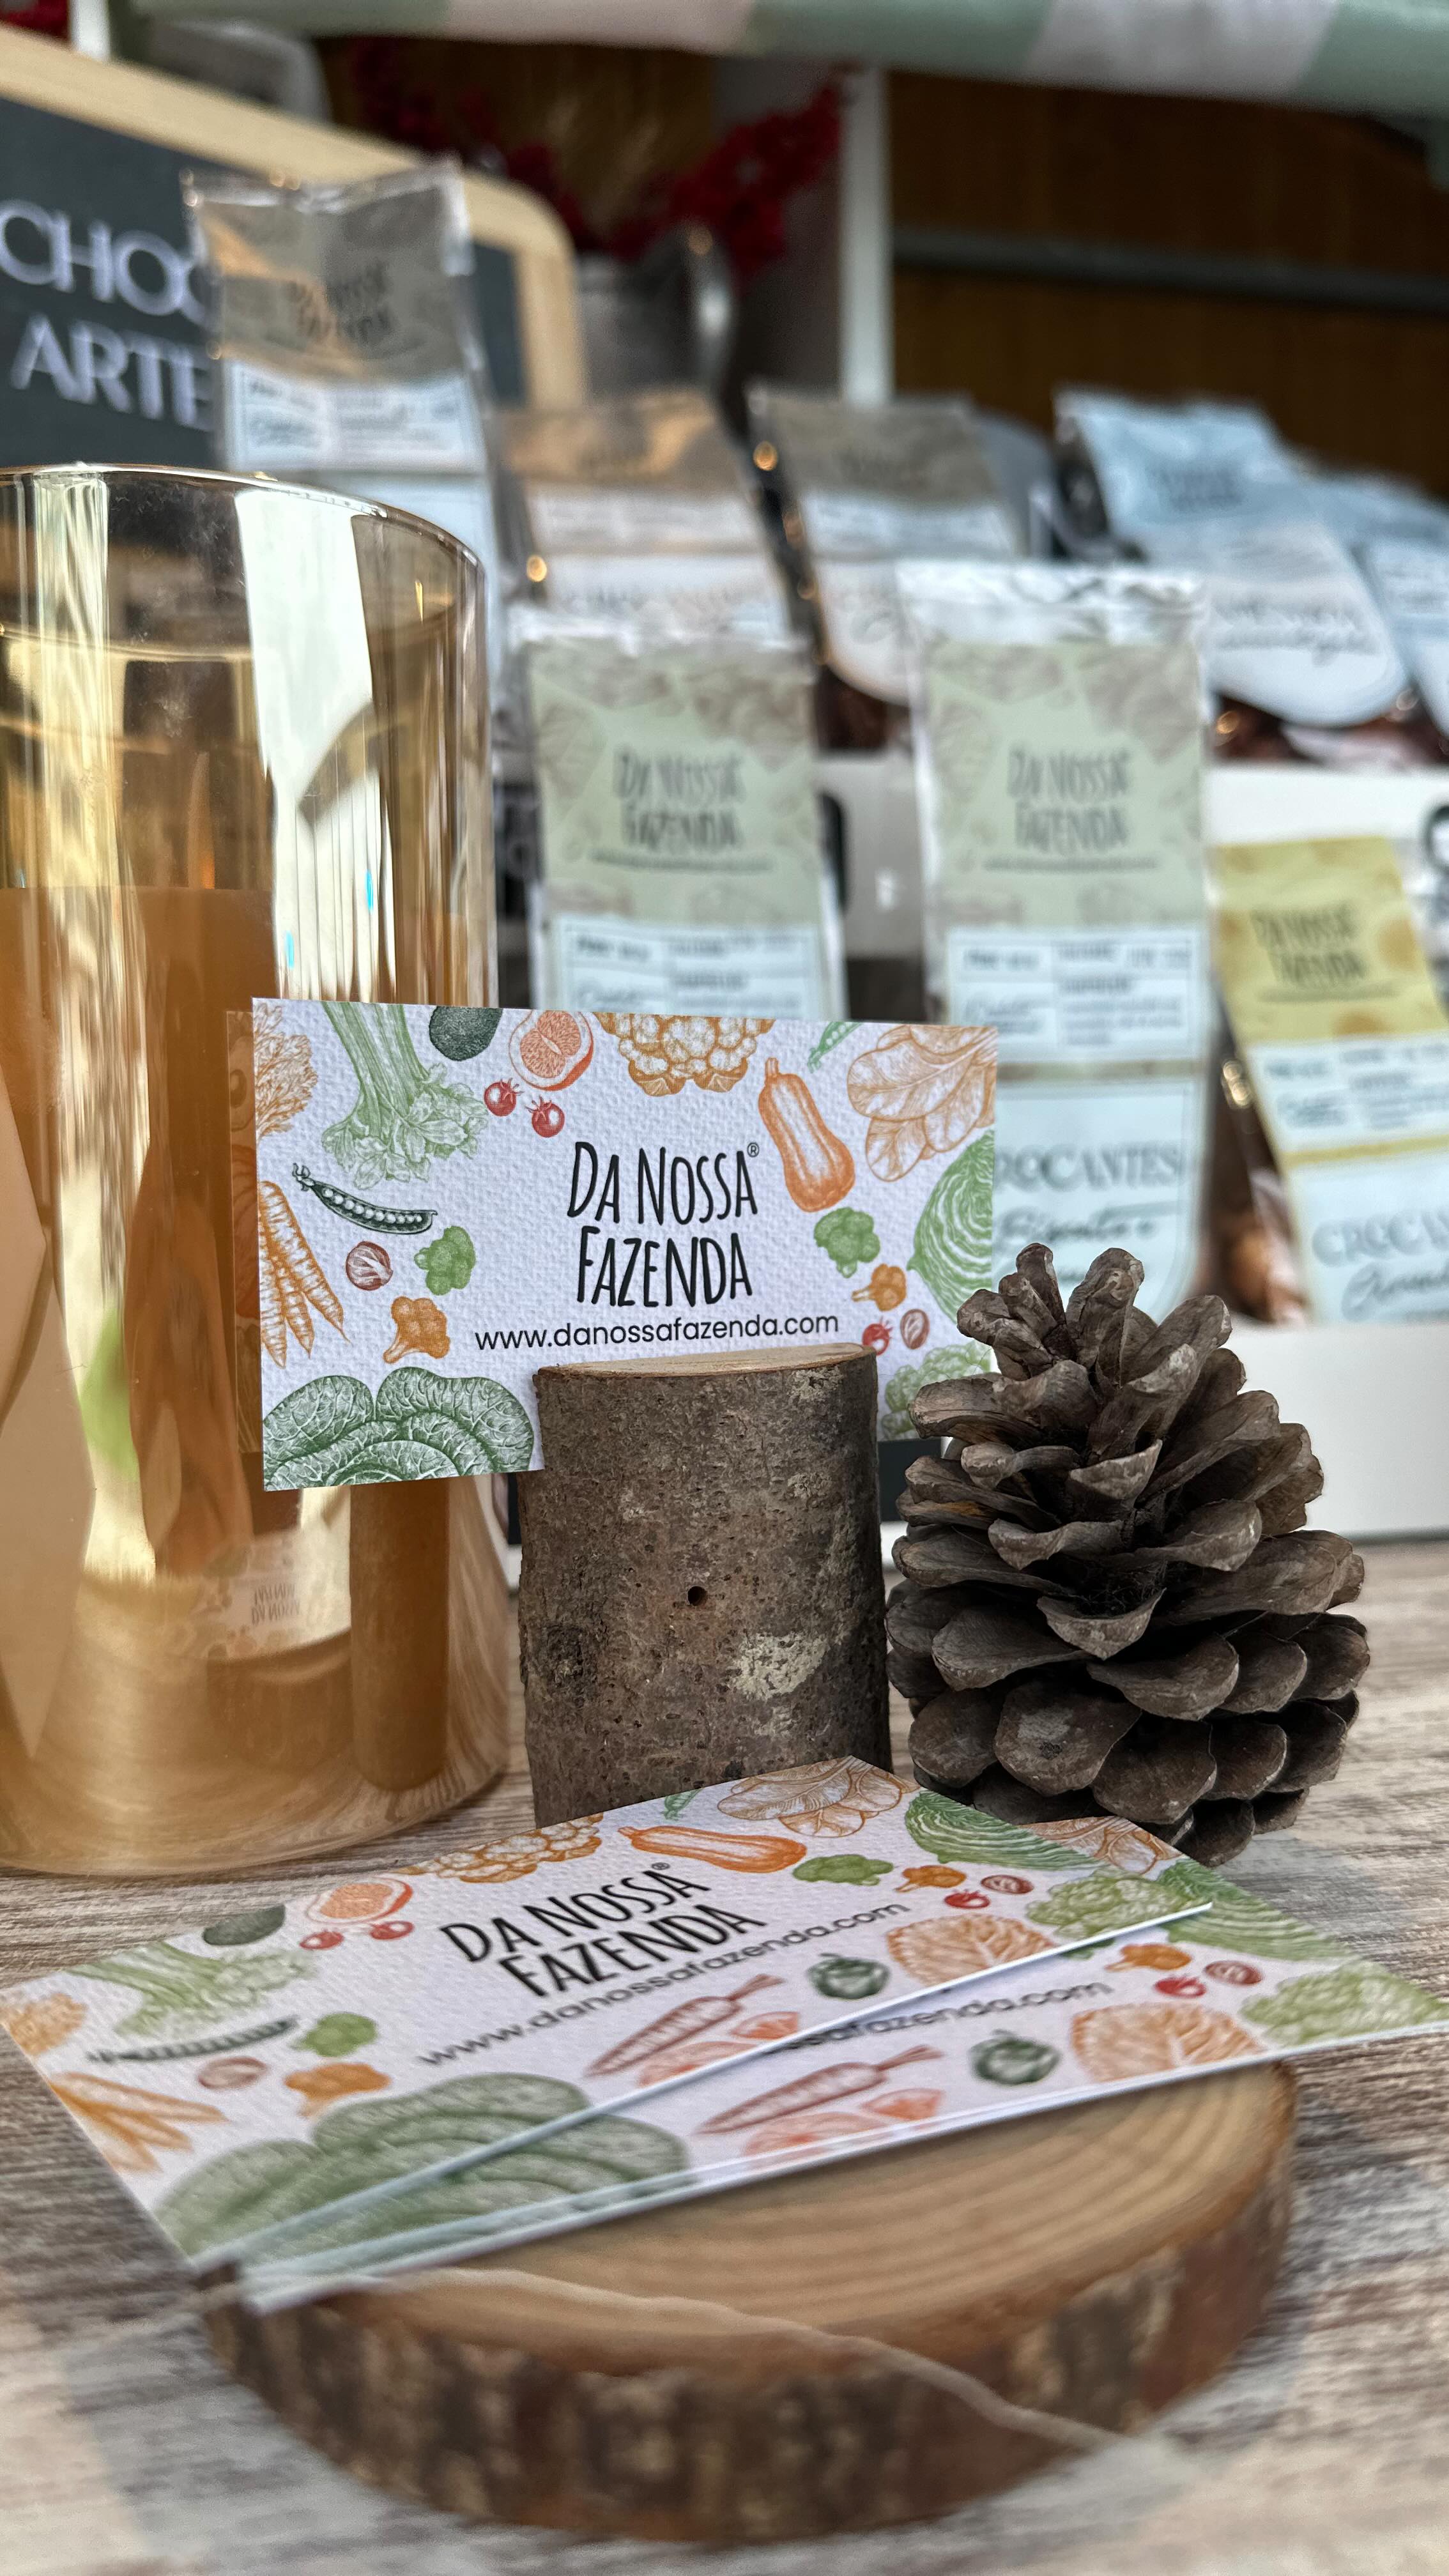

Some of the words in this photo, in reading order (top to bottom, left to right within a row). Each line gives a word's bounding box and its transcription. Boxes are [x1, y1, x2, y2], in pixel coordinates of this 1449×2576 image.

[567, 1141, 620, 1224] DA
[576, 1225, 753, 1308] FAZENDA
[475, 1314, 838, 1351] www.danossafazenda.com
[441, 1917, 542, 1963] DA
[498, 1904, 767, 1998] FAZENDA
[416, 1903, 911, 2065] www.danossafazenda.com
